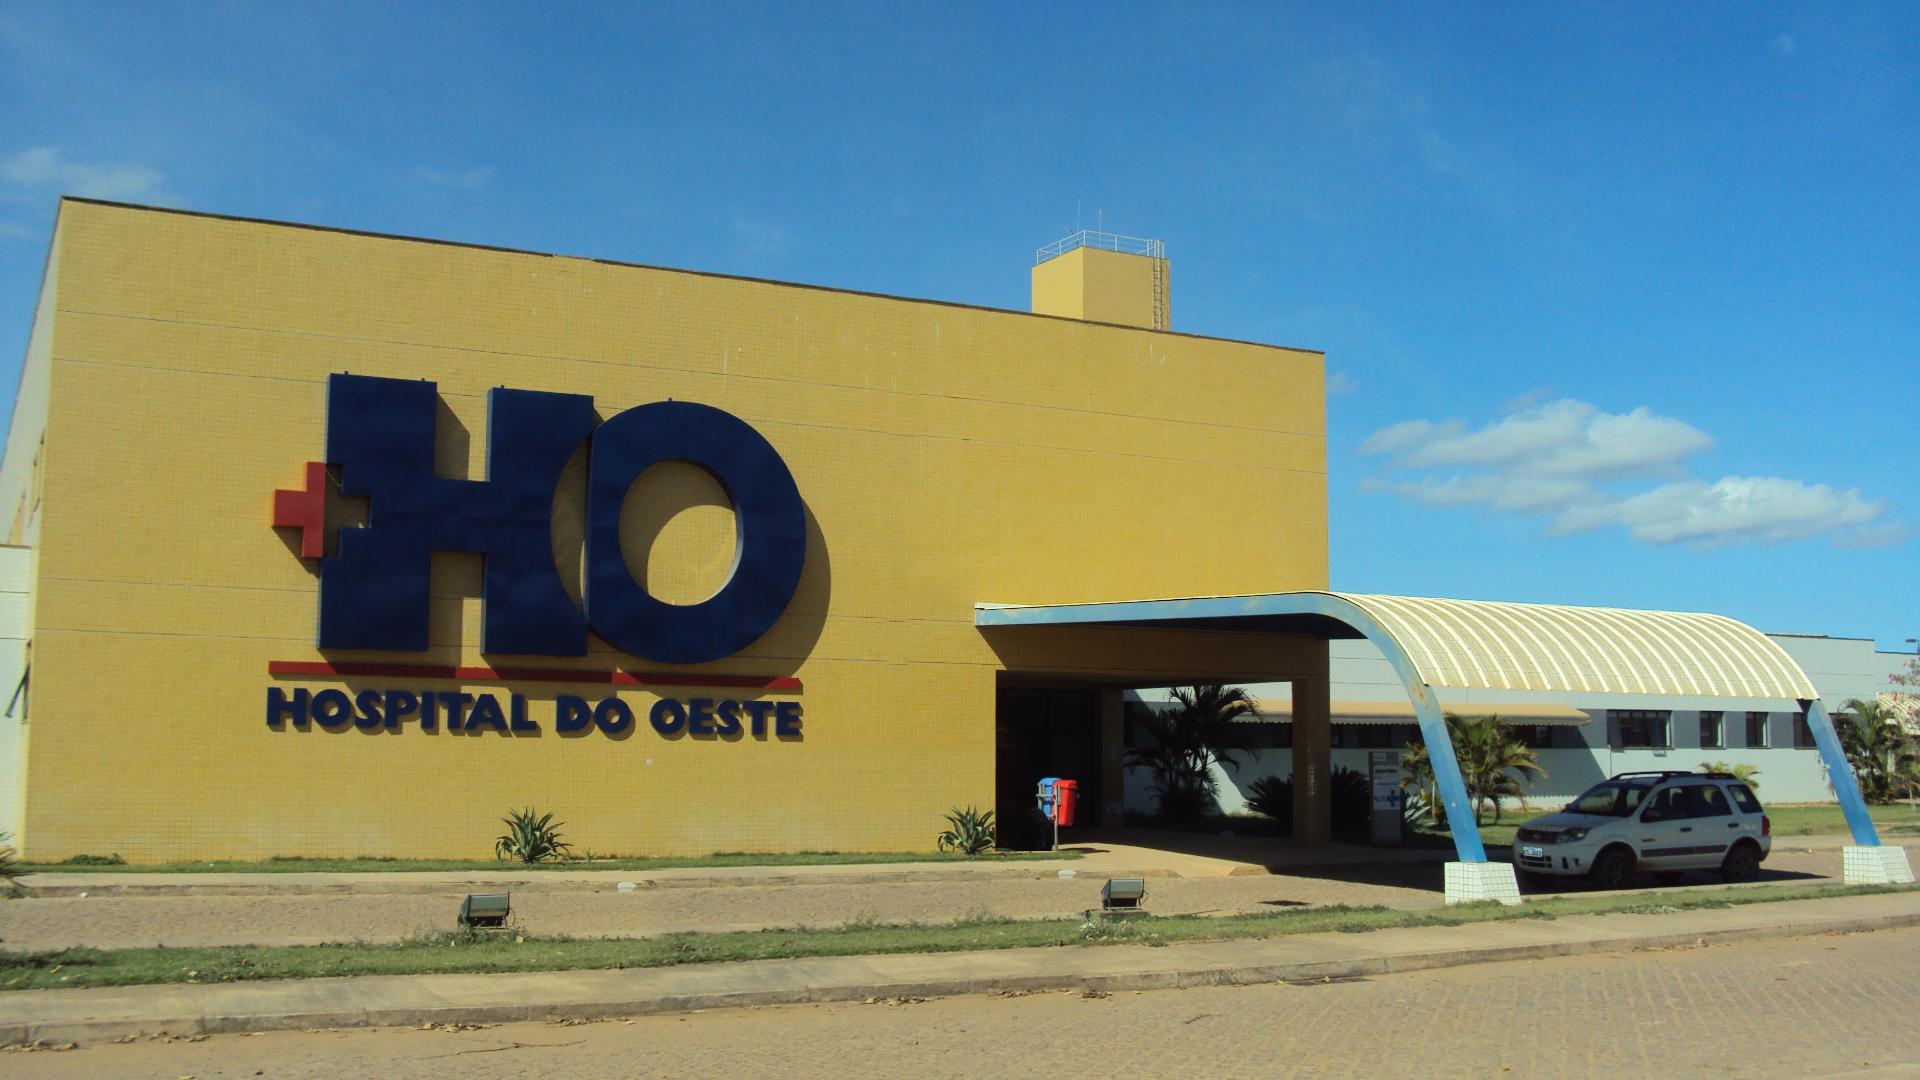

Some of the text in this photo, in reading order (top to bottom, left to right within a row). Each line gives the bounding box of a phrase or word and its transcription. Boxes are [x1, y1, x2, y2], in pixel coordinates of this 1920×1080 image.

[318, 372, 806, 664] HO
[266, 686, 801, 736] HOSPITAL DO OESTE
